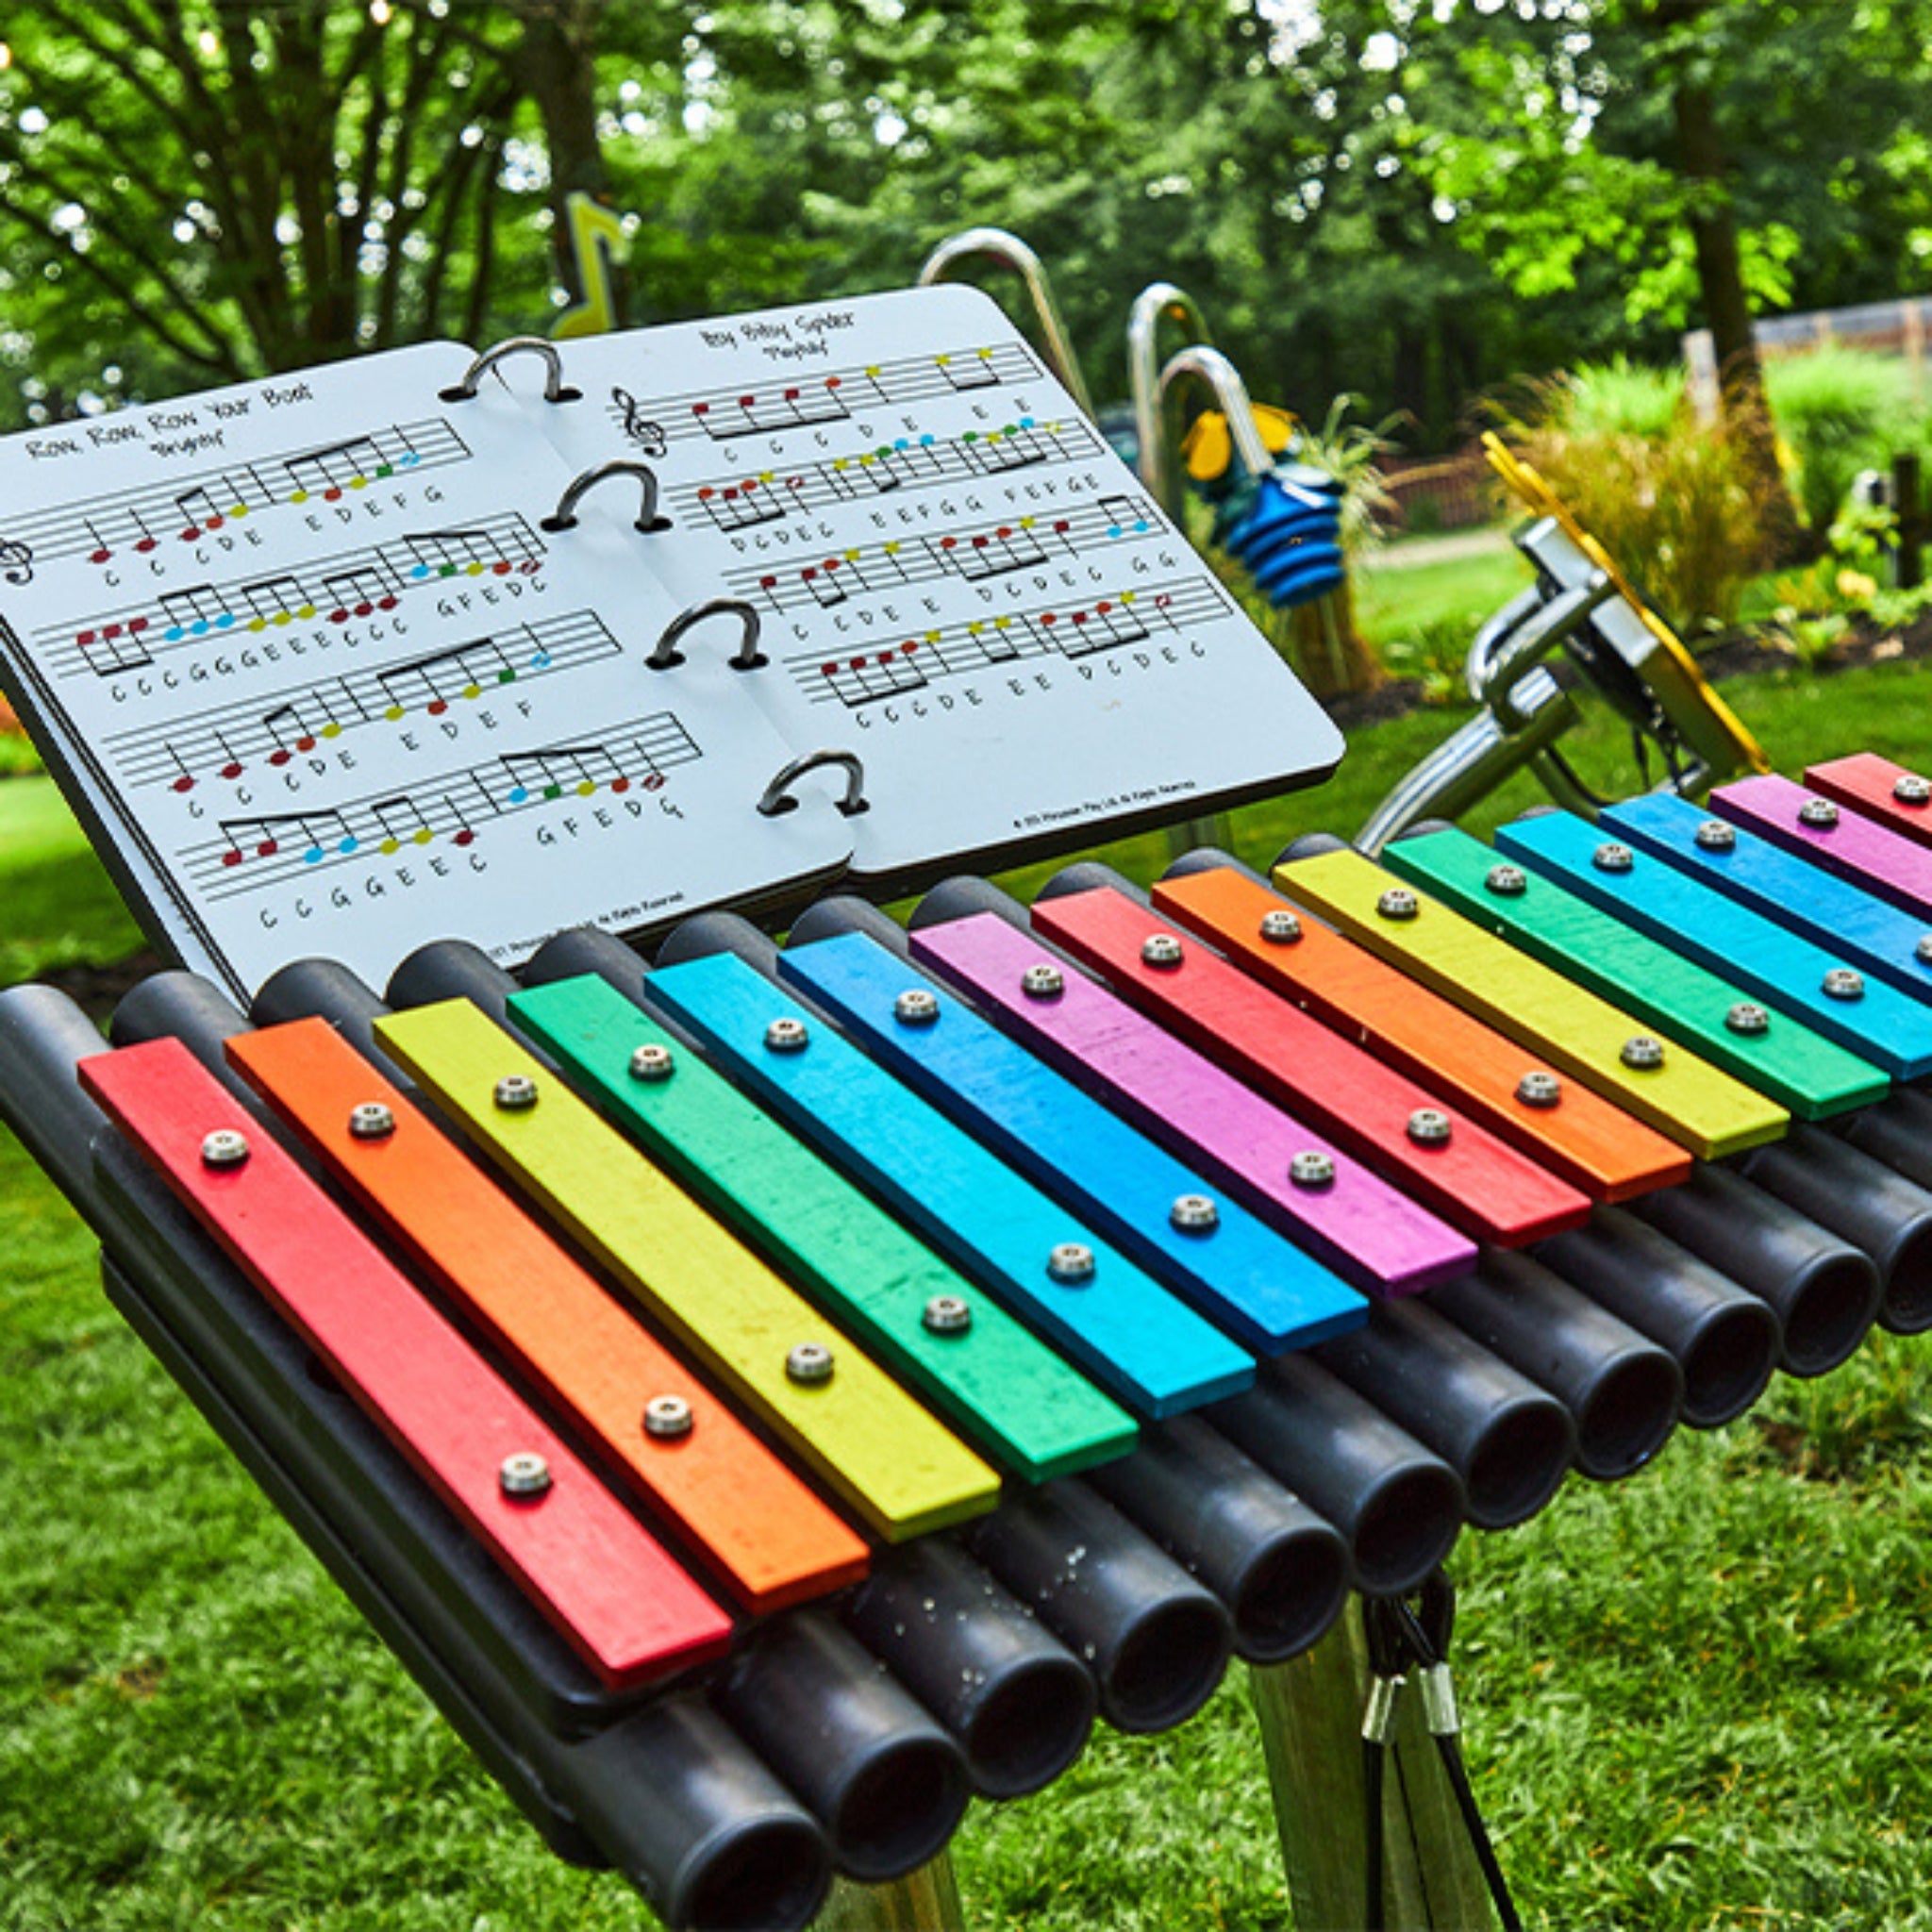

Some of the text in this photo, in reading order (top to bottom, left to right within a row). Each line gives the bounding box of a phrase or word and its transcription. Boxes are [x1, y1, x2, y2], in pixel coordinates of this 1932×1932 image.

[147, 410, 198, 434] Row
[724, 398, 1031, 463] C C C D E E E
[104, 570, 121, 588] C
[149, 559, 166, 577] C
[195, 548, 210, 565] C
[216, 536, 235, 552] D
[243, 528, 262, 547] E
[304, 514, 323, 532] E
[334, 508, 353, 525] D
[363, 499, 383, 518] E
[424, 485, 444, 503] G
[729, 538, 747, 554] D
[755, 534, 770, 551] C
[773, 530, 791, 545] D
[794, 525, 812, 542] E
[817, 522, 835, 539] C
[869, 512, 887, 529] E
[896, 508, 913, 525] E
[940, 499, 958, 516] G
[965, 494, 984, 512] G
[1024, 484, 1041, 500] E
[1067, 476, 1083, 493] G
[1083, 473, 1099, 491] E
[111, 685, 127, 703] C
[137, 678, 153, 696] C
[162, 670, 179, 690] C
[189, 662, 210, 682] G
[214, 656, 236, 675] G
[240, 649, 261, 668] G
[261, 643, 281, 662] E
[287, 637, 307, 656] E
[311, 630, 332, 650] E
[342, 630, 359, 648] C
[369, 624, 385, 641] C
[391, 617, 408, 635] C
[436, 598, 458, 617] G
[479, 586, 500, 605] E
[505, 582, 523, 598] D
[530, 576, 547, 593] C
[791, 551, 1176, 641] C C D E E D C D E C G G
[855, 641, 1206, 729] C C C D E E E D C D E C
[188, 800, 205, 819] C
[235, 786, 253, 806] C
[283, 772, 301, 792] C
[308, 758, 326, 777] D
[336, 749, 357, 770] E
[399, 732, 420, 752] E
[440, 722, 458, 741] D
[477, 710, 498, 730] E
[259, 908, 278, 929] C
[295, 898, 313, 919] C
[330, 887, 352, 908] G
[365, 875, 387, 898] G
[395, 867, 416, 888] E
[427, 856, 450, 877] E
[469, 853, 488, 874] C
[536, 824, 558, 846] G
[591, 808, 613, 828] E
[624, 800, 642, 819] D
